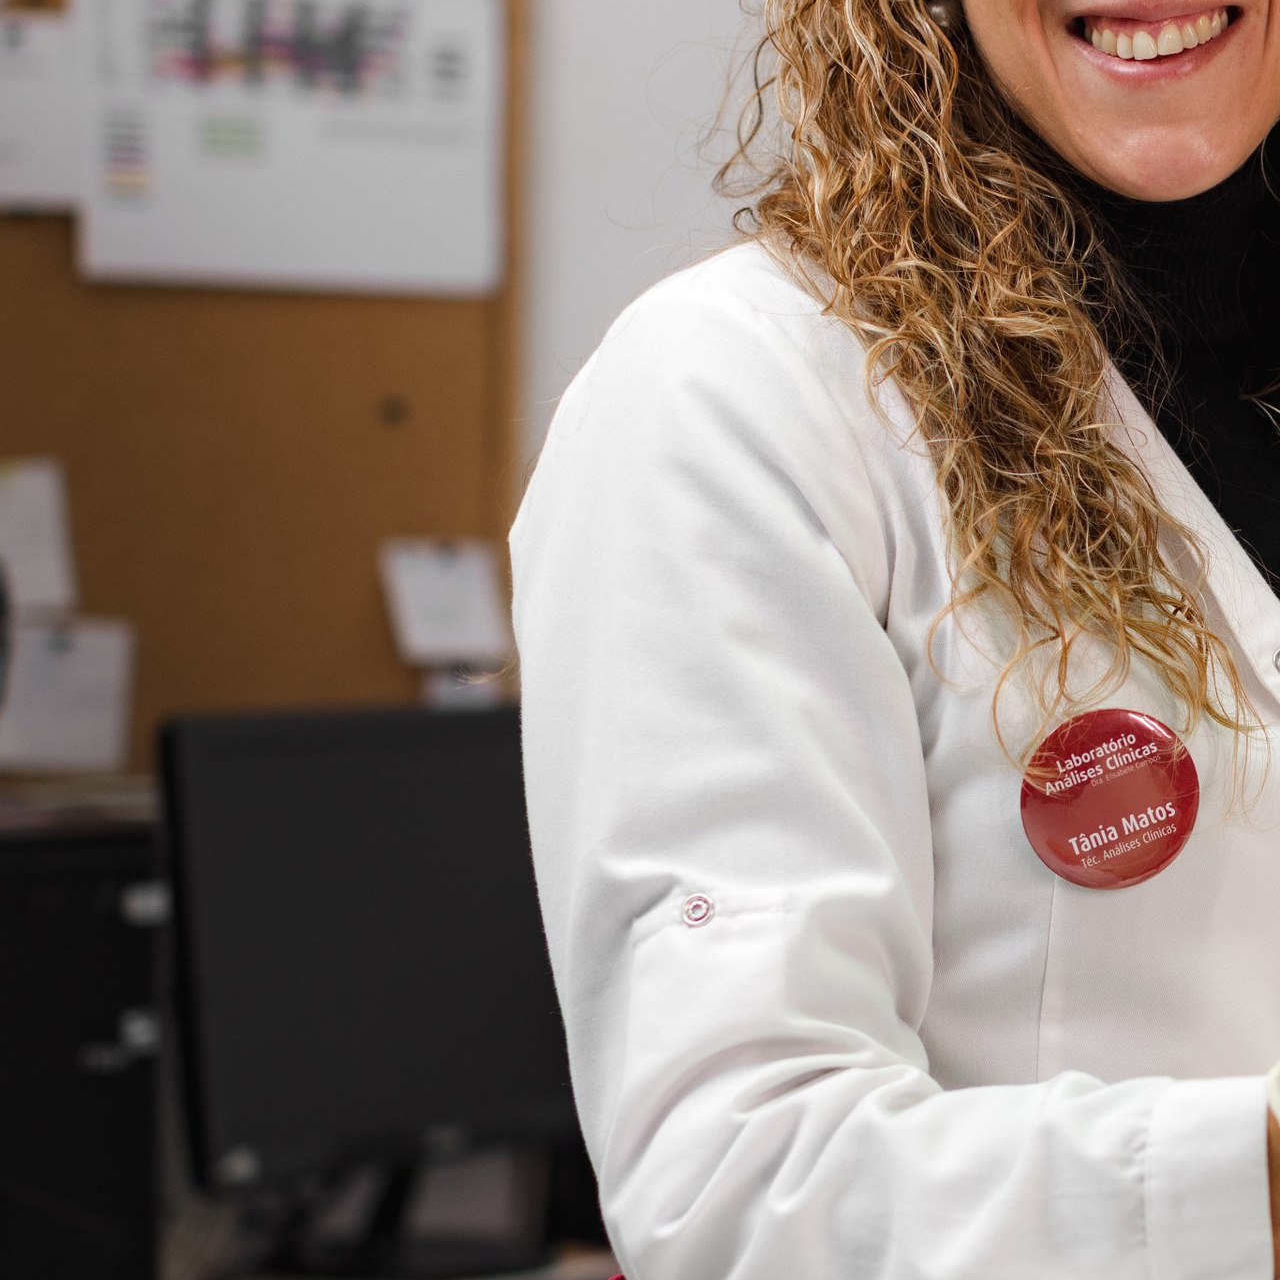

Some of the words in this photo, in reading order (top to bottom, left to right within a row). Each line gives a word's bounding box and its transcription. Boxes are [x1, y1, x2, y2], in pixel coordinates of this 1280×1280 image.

[1045, 763, 1104, 796] Análises
[1106, 742, 1158, 770] Clínicas
[1056, 733, 1136, 773] Laboratório
[1135, 755, 1161, 769] Campos
[1068, 824, 1119, 855] Tânia
[1121, 802, 1176, 835] Matos
[1081, 856, 1101, 869] Téc.
[1103, 839, 1141, 861] Análises
[1142, 823, 1177, 844] Clínicas
